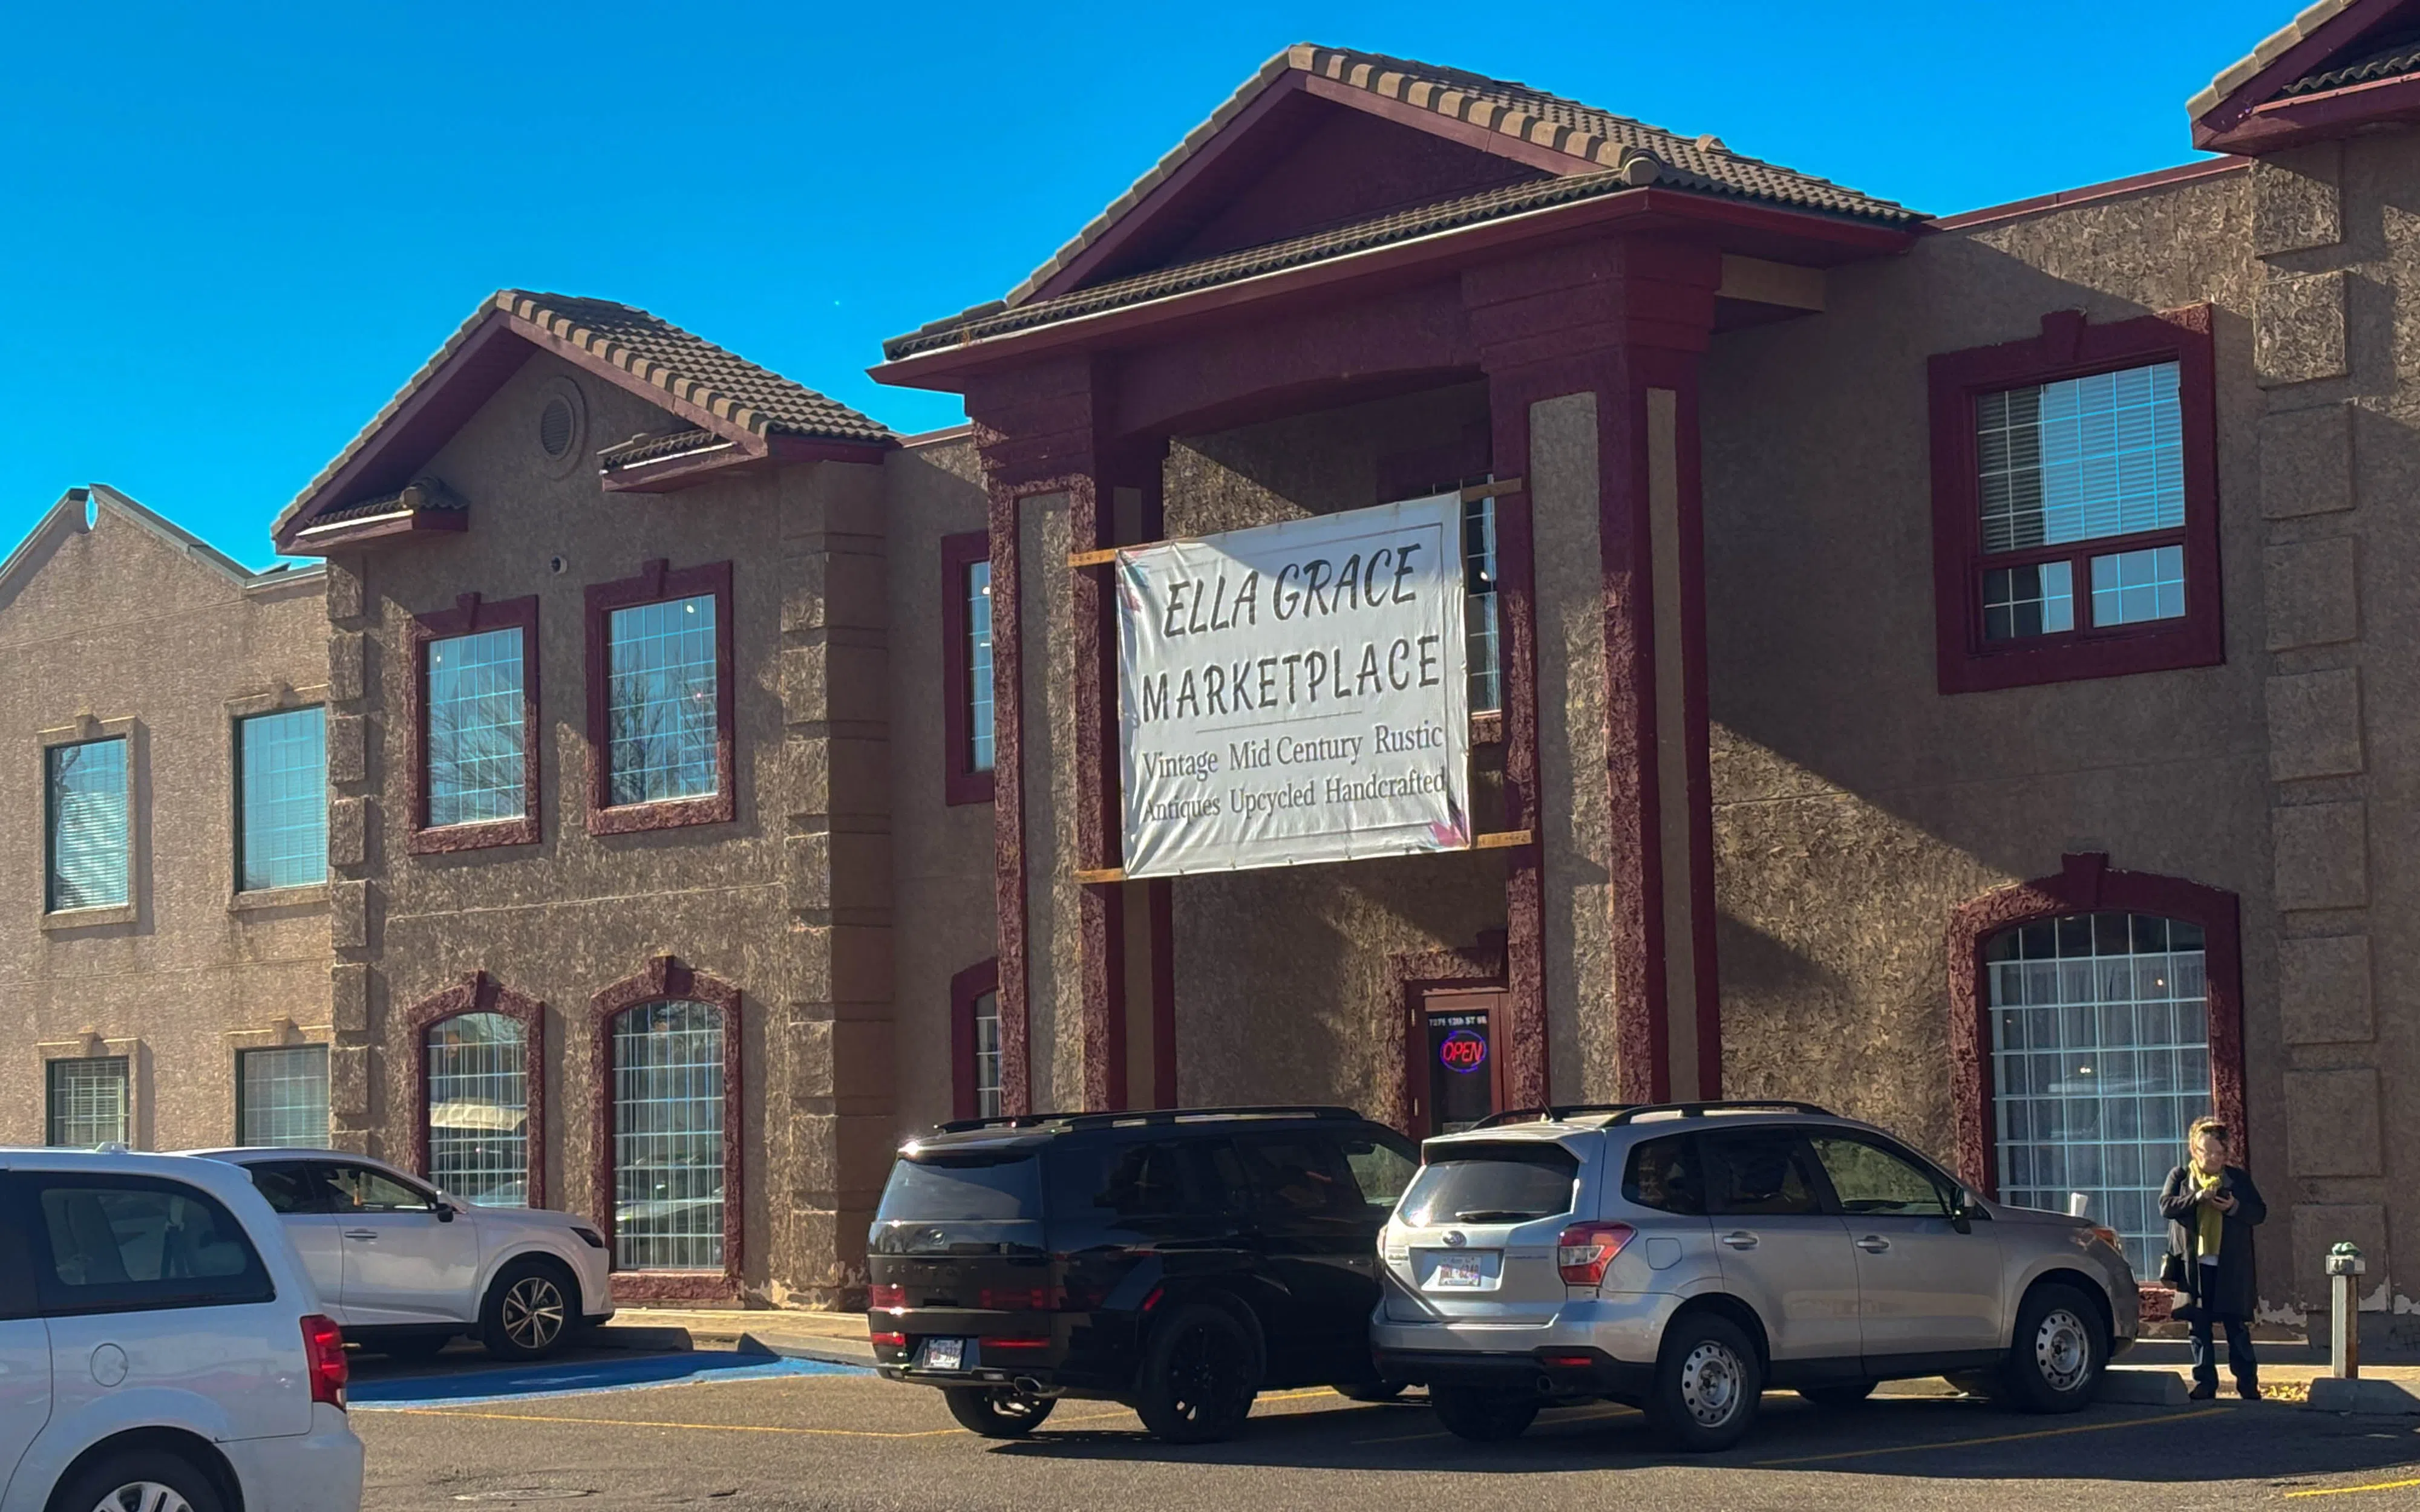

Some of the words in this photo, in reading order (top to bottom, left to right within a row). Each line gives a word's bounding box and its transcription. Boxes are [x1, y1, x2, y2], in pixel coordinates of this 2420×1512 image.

[1162, 570, 1259, 638] ELLA
[1272, 543, 1422, 621] GRACE
[1142, 635, 1441, 723] MARKETPLACE
[1143, 751, 1218, 782] Vintage
[1229, 738, 1271, 771] Mid
[1277, 736, 1364, 766] Century
[1374, 719, 1443, 754] Rustic
[1142, 795, 1221, 824] Antiques
[1229, 780, 1316, 820] Upcycled
[1325, 766, 1448, 804] Handcrafted
[1465, 1016, 1476, 1025] ST
[1442, 1041, 1482, 1063] OPEN
